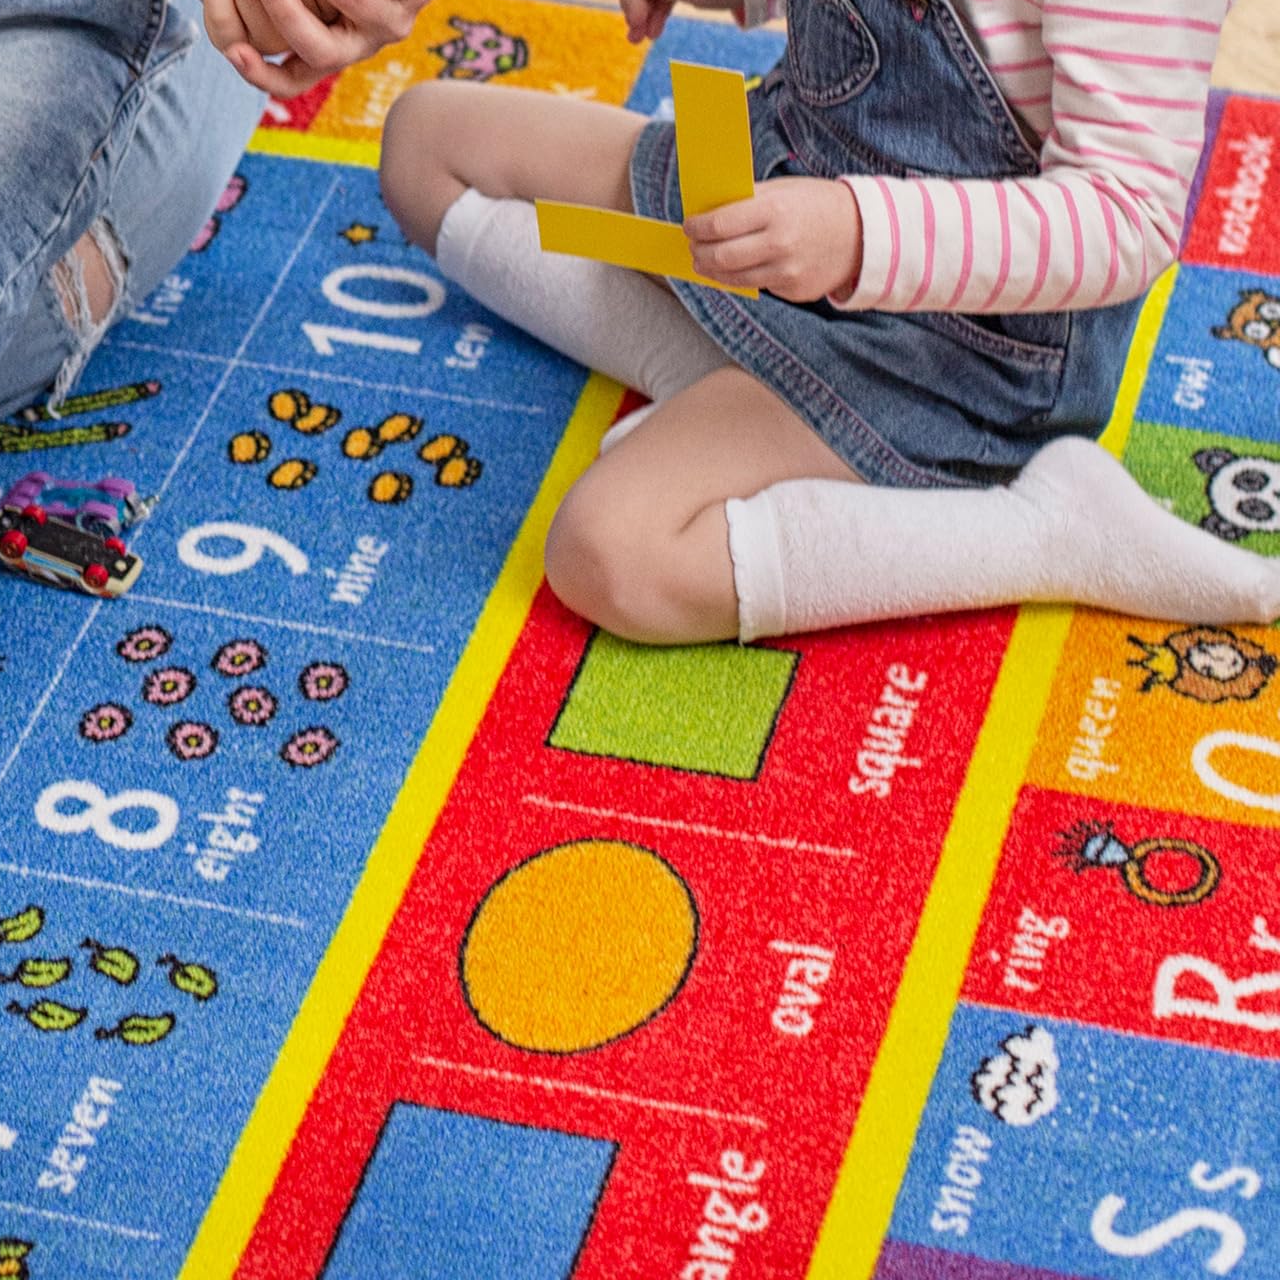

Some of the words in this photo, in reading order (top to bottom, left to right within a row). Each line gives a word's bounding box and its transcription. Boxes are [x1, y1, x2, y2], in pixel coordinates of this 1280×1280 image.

[300, 264, 446, 355] 10
[177, 521, 310, 575] 9
[329, 534, 389, 606] nine
[849, 662, 928, 798] square
[1066, 676, 1122, 781] queen
[34, 779, 180, 850] 8
[195, 785, 265, 881] eight
[770, 940, 835, 1037] oval
[990, 907, 1070, 992] ring
[38, 1075, 123, 1195] seven
[931, 1125, 993, 1235] snow
[681, 1148, 770, 1280] angle
